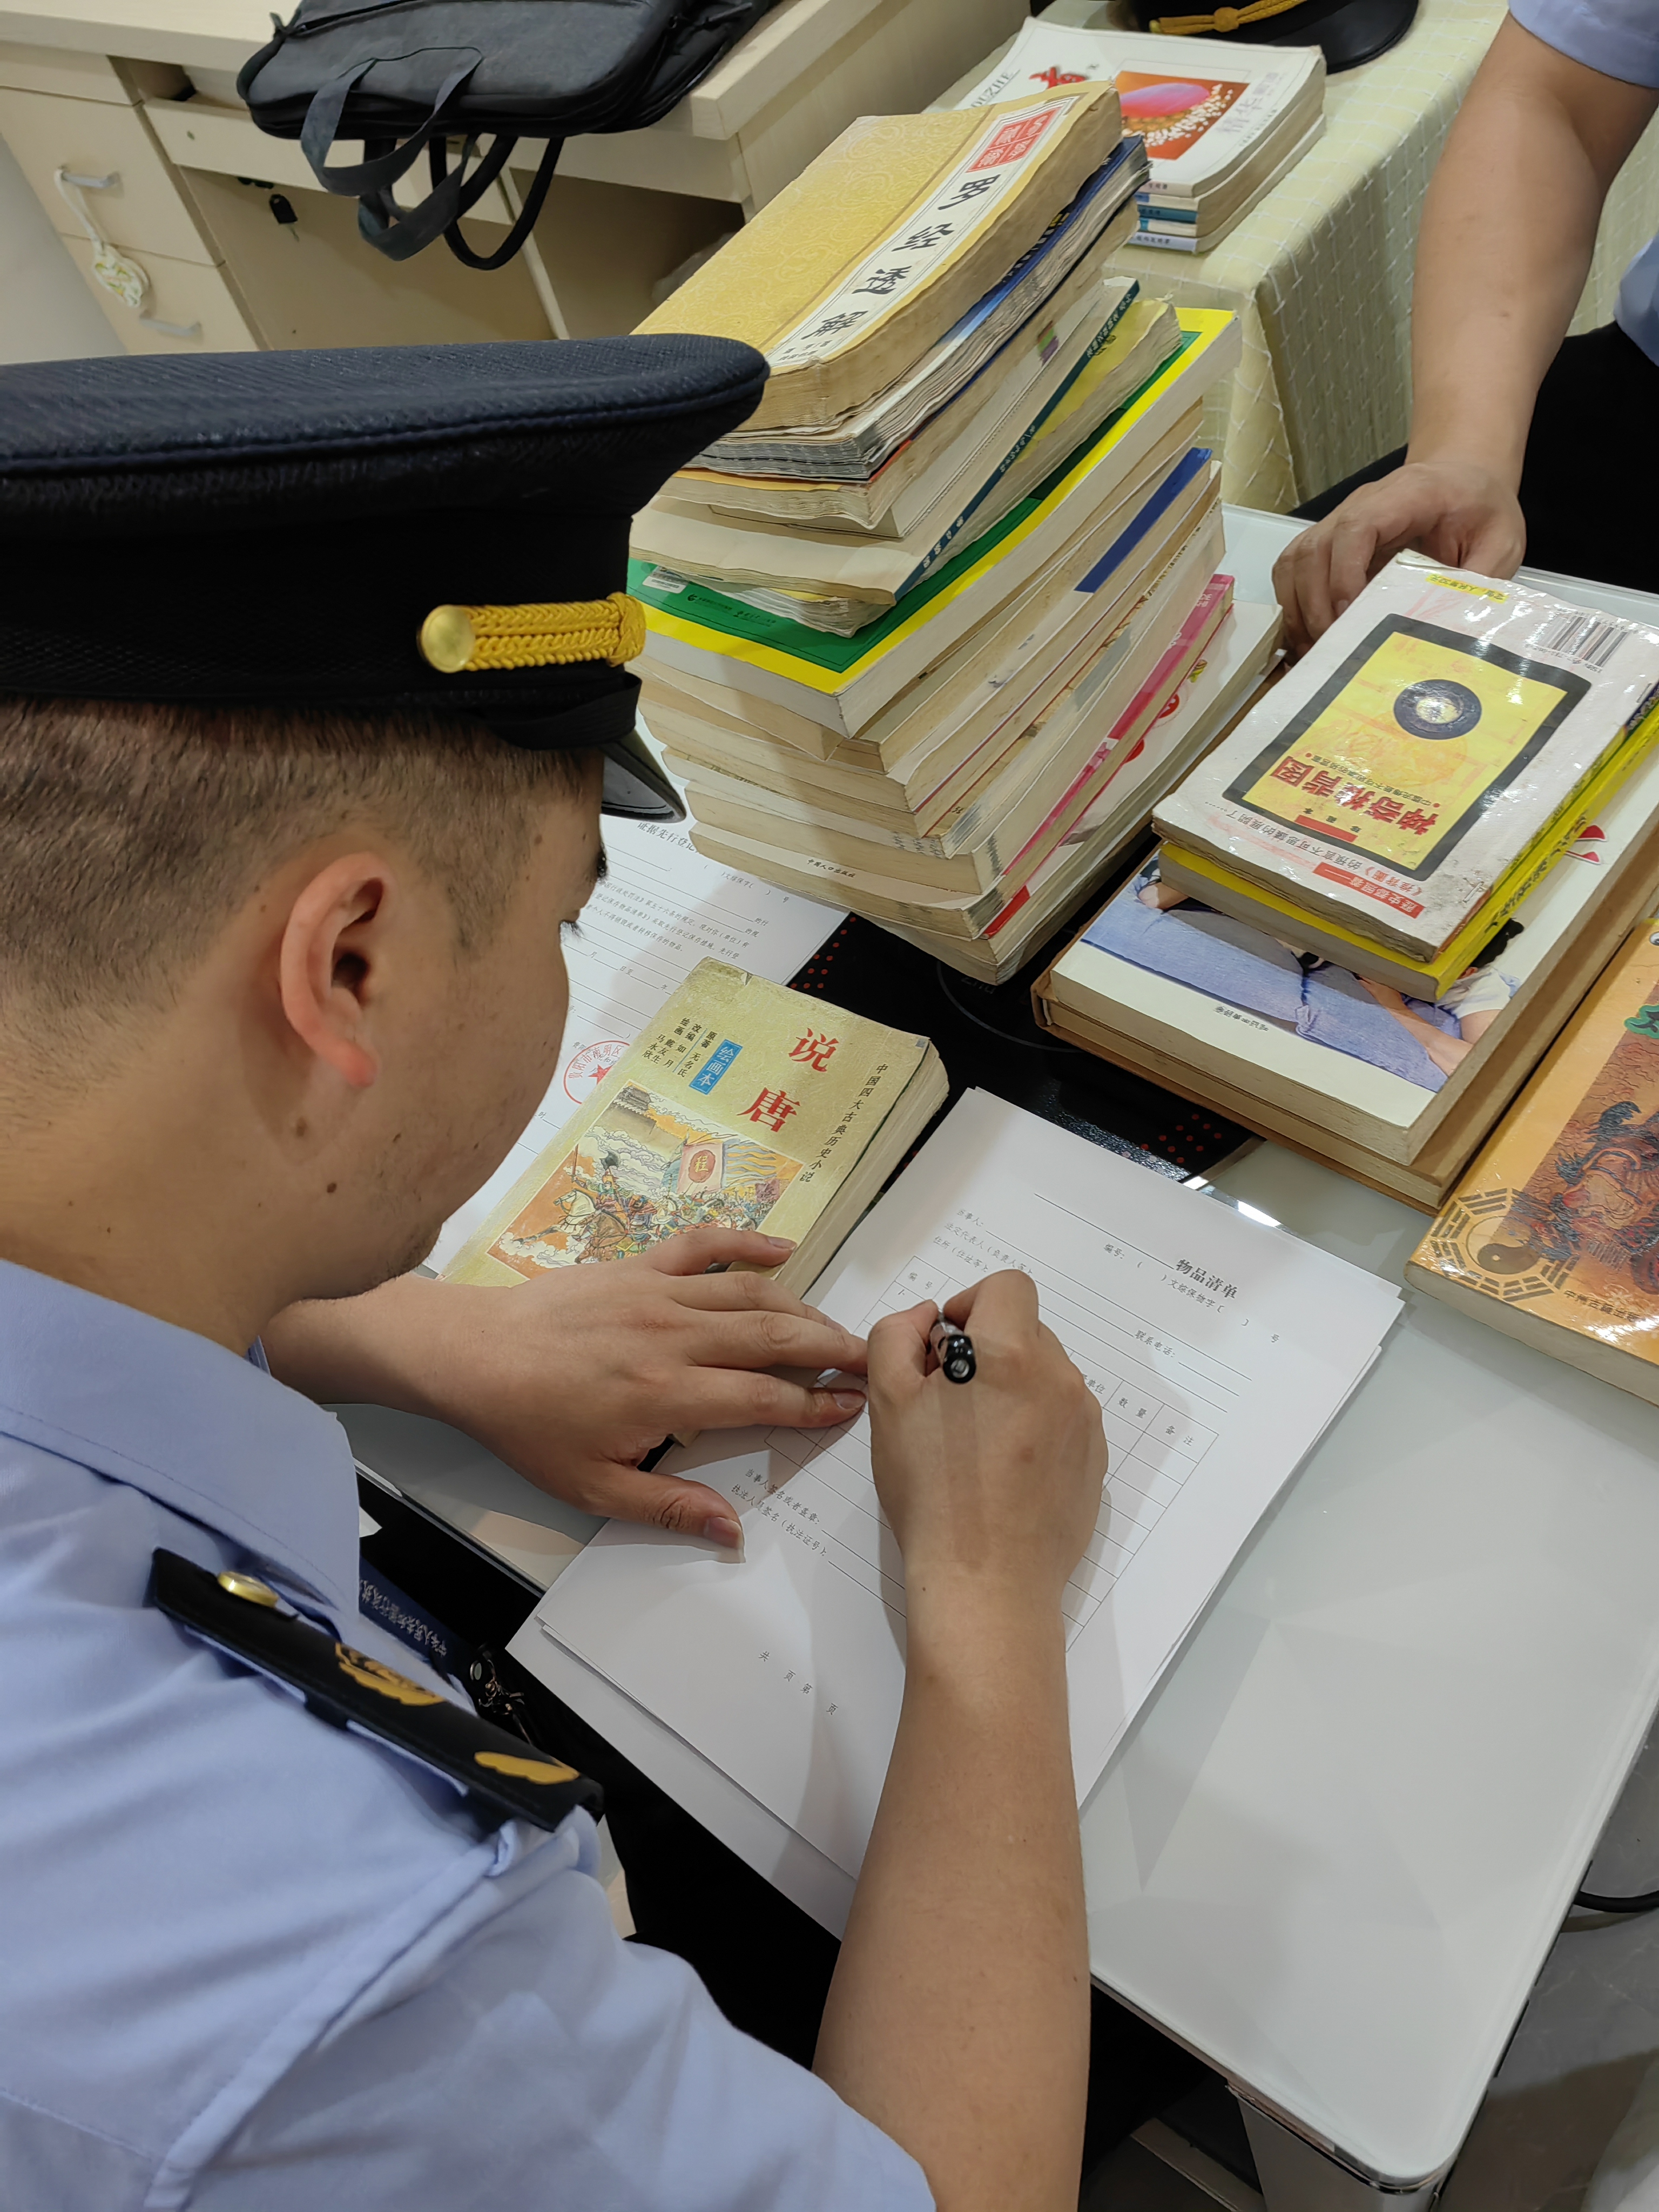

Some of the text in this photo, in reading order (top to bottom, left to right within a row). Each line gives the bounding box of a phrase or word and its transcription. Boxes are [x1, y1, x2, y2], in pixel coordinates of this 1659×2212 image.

[801, 174, 1003, 340] 罗经透解
[1274, 755, 1440, 836] 神奇推背图
[637, 822, 700, 854] 证据先行登记
[807, 858, 857, 879] 中国人口出版社
[782, 895, 790, 903] 号
[754, 917, 769, 927] 的行
[673, 1017, 690, 1035] 绘画
[685, 1024, 702, 1041] 改编
[642, 1034, 666, 1060] 马永欣
[677, 1031, 718, 1077] 原著 无名氏
[698, 1047, 734, 1087] 绘画本
[799, 1063, 888, 1184] 中国四大古典历史小说
[1176, 1259, 1238, 1299] 物品清单
[1564, 1290, 1645, 1322] 中州古籍出版
[1271, 1334, 1280, 1343] 号
[759, 1650, 839, 1716] 共 页 第 页
